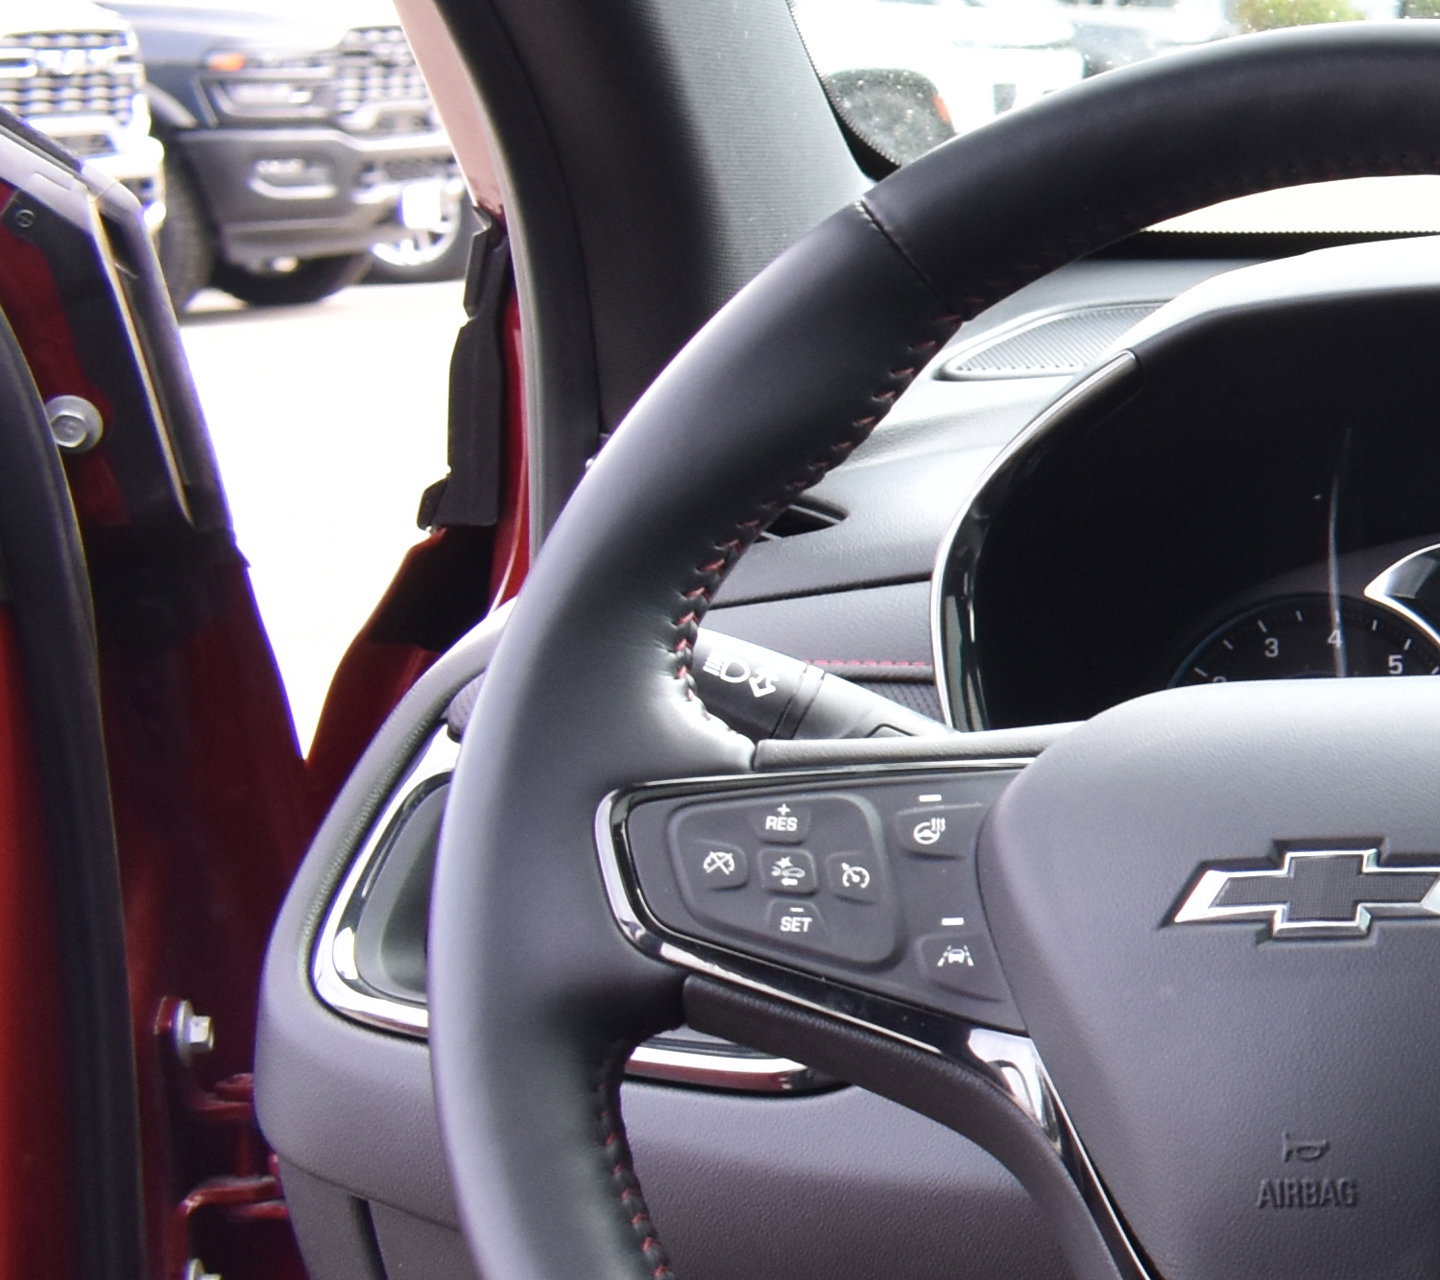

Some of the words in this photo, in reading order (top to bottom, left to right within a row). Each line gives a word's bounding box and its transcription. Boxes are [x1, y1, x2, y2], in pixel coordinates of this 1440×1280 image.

[1264, 637, 1280, 658] 3
[1327, 628, 1344, 648] 4
[1387, 654, 1404, 675] 5
[765, 816, 798, 832] RES
[779, 915, 813, 933] SET
[1257, 1179, 1358, 1208] AIRBAG
